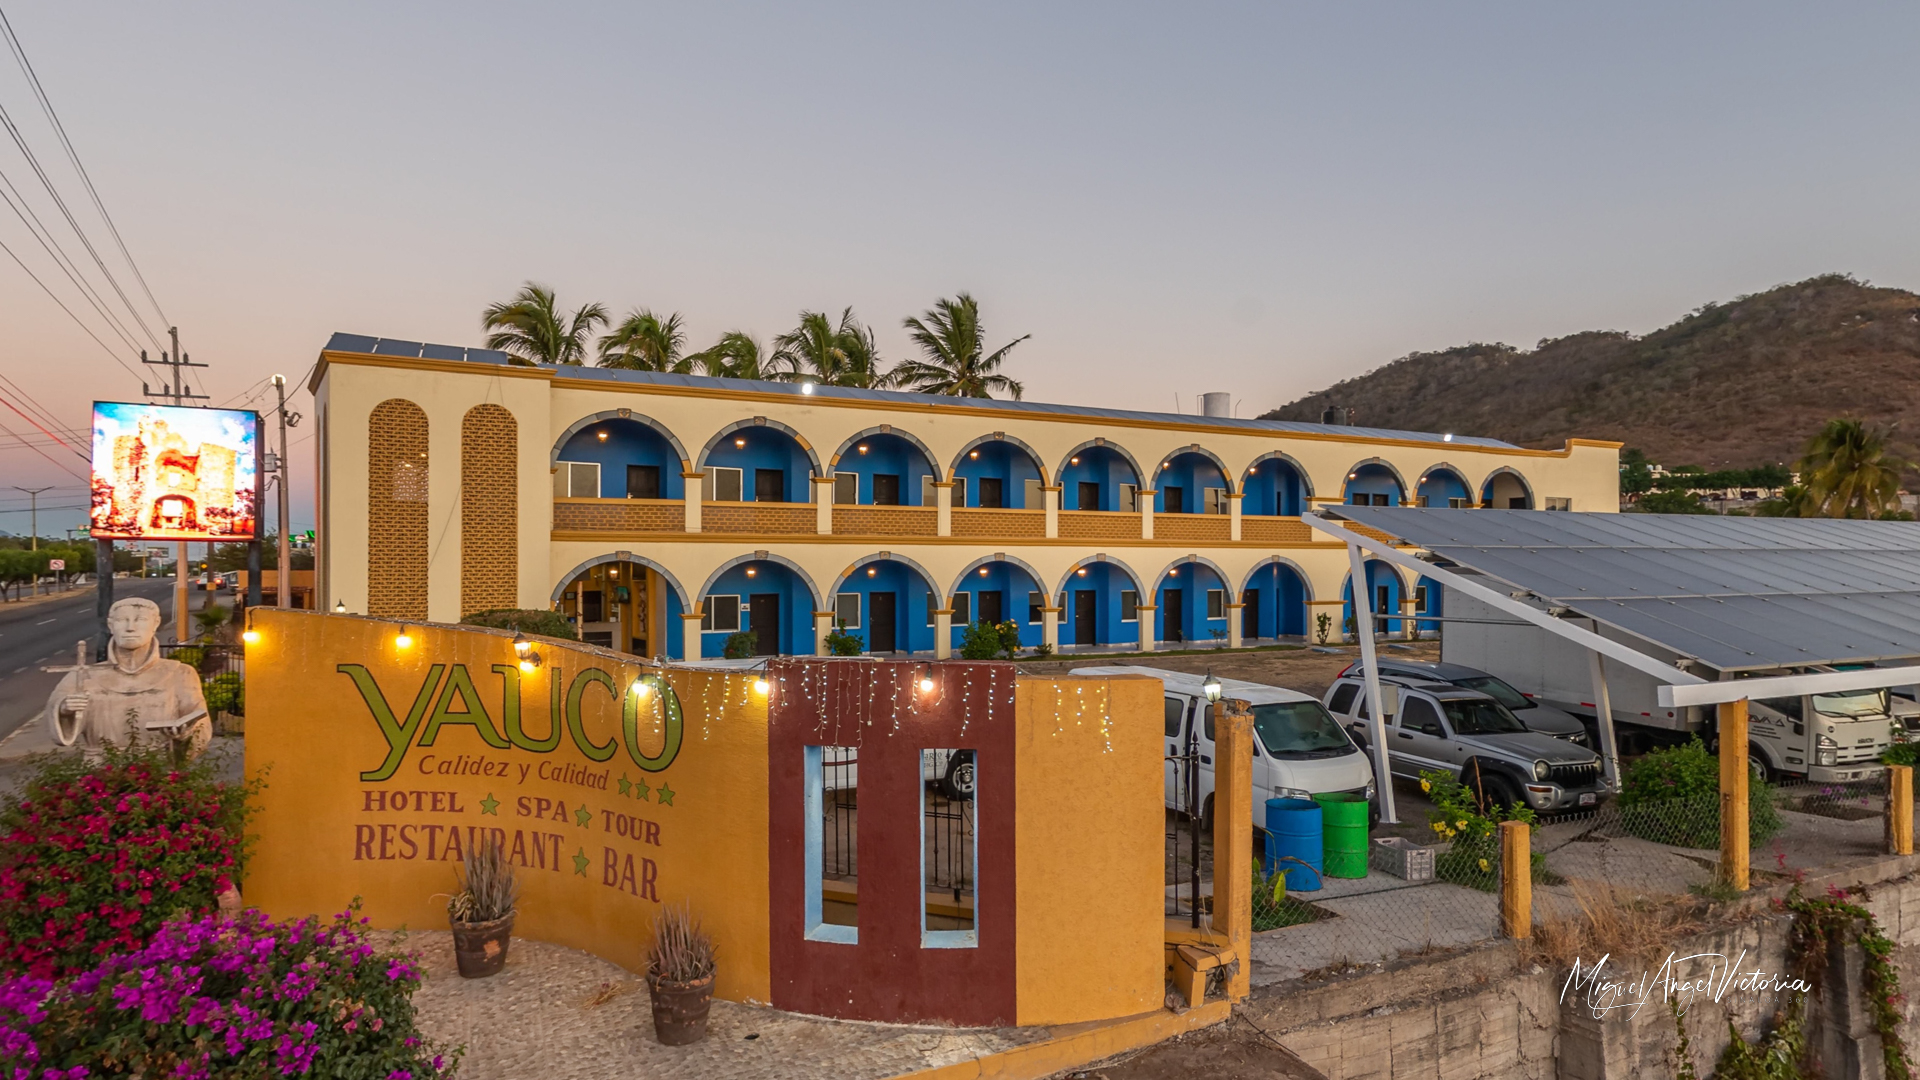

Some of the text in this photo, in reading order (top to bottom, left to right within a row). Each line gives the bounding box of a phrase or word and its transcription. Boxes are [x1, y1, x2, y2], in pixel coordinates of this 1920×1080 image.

[336, 663, 684, 782] YAUCO
[418, 754, 610, 791] Calidez y Calidad
[361, 790, 662, 847] HOTEL SPA TOUR
[603, 846, 661, 903] BAR
